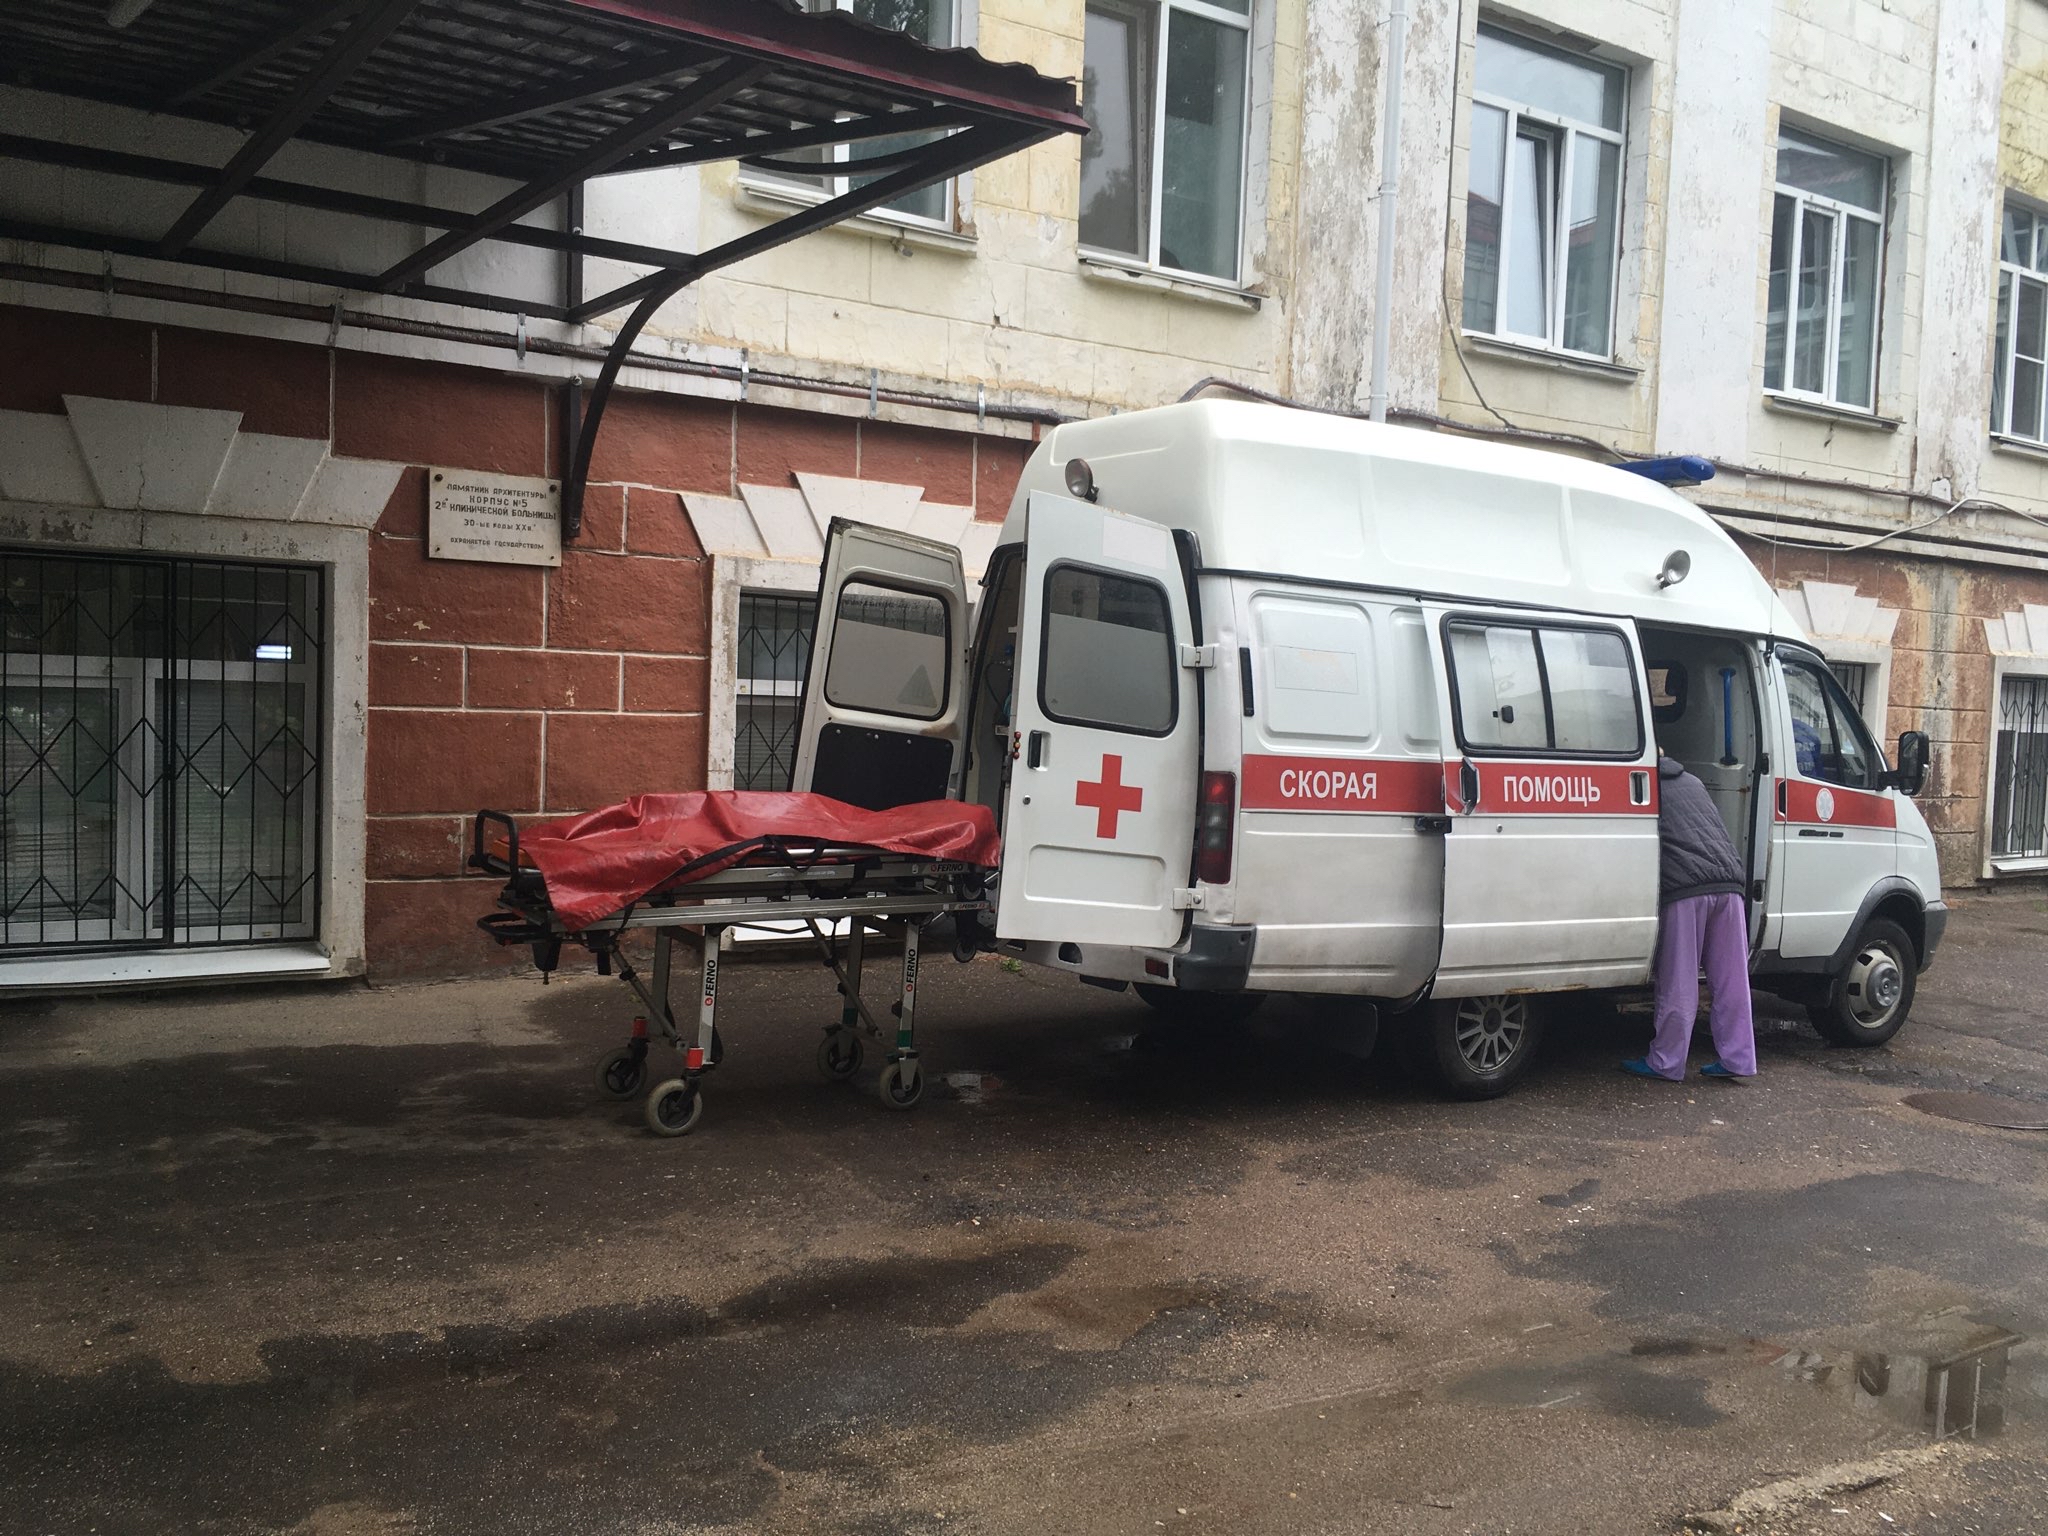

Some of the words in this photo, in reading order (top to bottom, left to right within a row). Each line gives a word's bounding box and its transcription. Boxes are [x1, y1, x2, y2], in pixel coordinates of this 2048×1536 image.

[446, 483, 489, 494] ПАМЯТНИК
[493, 488, 547, 499] АРХИТЕКТУРЫ
[469, 495, 509, 506] КОРПУС
[449, 503, 509, 516] КЛИНИЧЕСКОЙ
[511, 509, 557, 520] БОЛЬНИЦЫ
[450, 537, 491, 546] ОХРАНЯЕТСЯ
[494, 540, 545, 550] ГОСУДАРСТВОМ
[1280, 769, 1377, 800] СКОРАЯ
[1503, 775, 1601, 807] ПОМОЩЬ
[937, 863, 964, 873] FERNO
[906, 948, 916, 984] FERNO
[705, 959, 716, 997] FERNO
